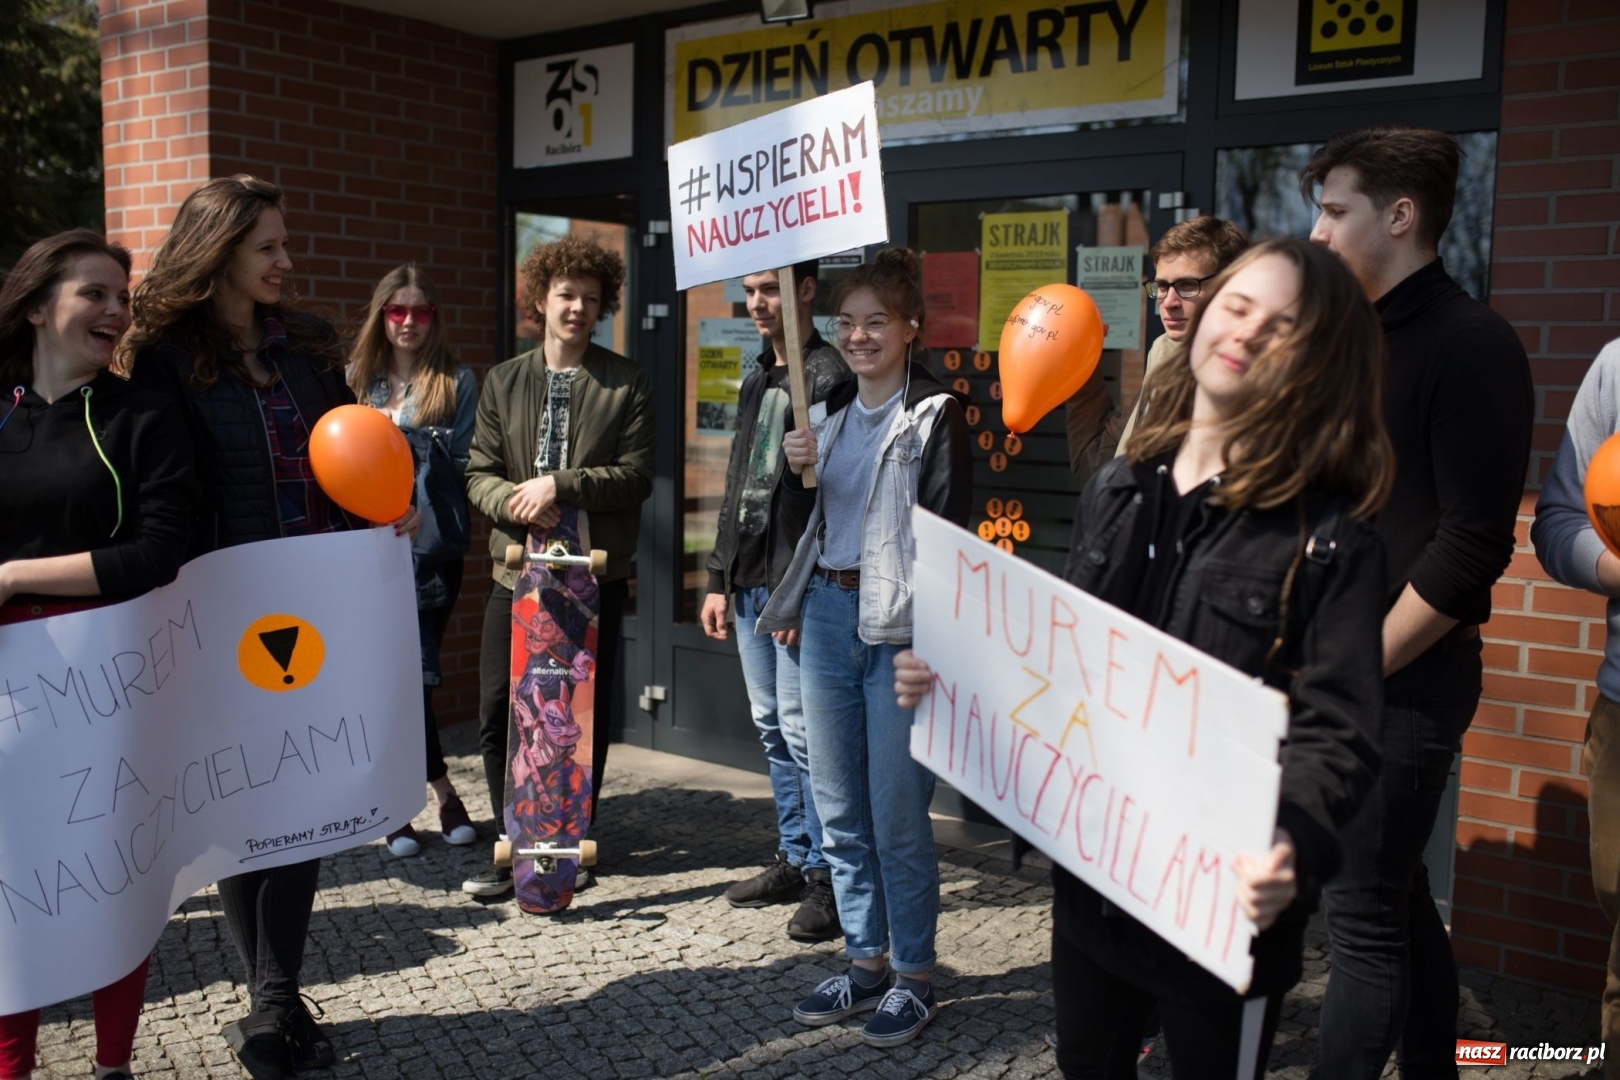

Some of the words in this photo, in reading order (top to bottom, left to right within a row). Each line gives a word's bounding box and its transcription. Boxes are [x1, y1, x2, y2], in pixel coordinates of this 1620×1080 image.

[687, 30, 830, 112] DZIEŃ
[846, 0, 1148, 88] OTWARTY
[678, 114, 868, 215] #WSPIERAM
[686, 170, 863, 258] NAUCZYCIELI!
[989, 221, 1062, 247] STRAJK
[1083, 254, 1135, 273] STRAJK
[0, 599, 203, 732] #MUREM
[532, 667, 574, 675] alternative
[954, 548, 1201, 759] MUREM
[1008, 665, 1098, 771] ZA
[0, 714, 372, 925] NAUCZYCIELAMI
[60, 756, 150, 825] ZA
[245, 828, 315, 853] POPIERAMY
